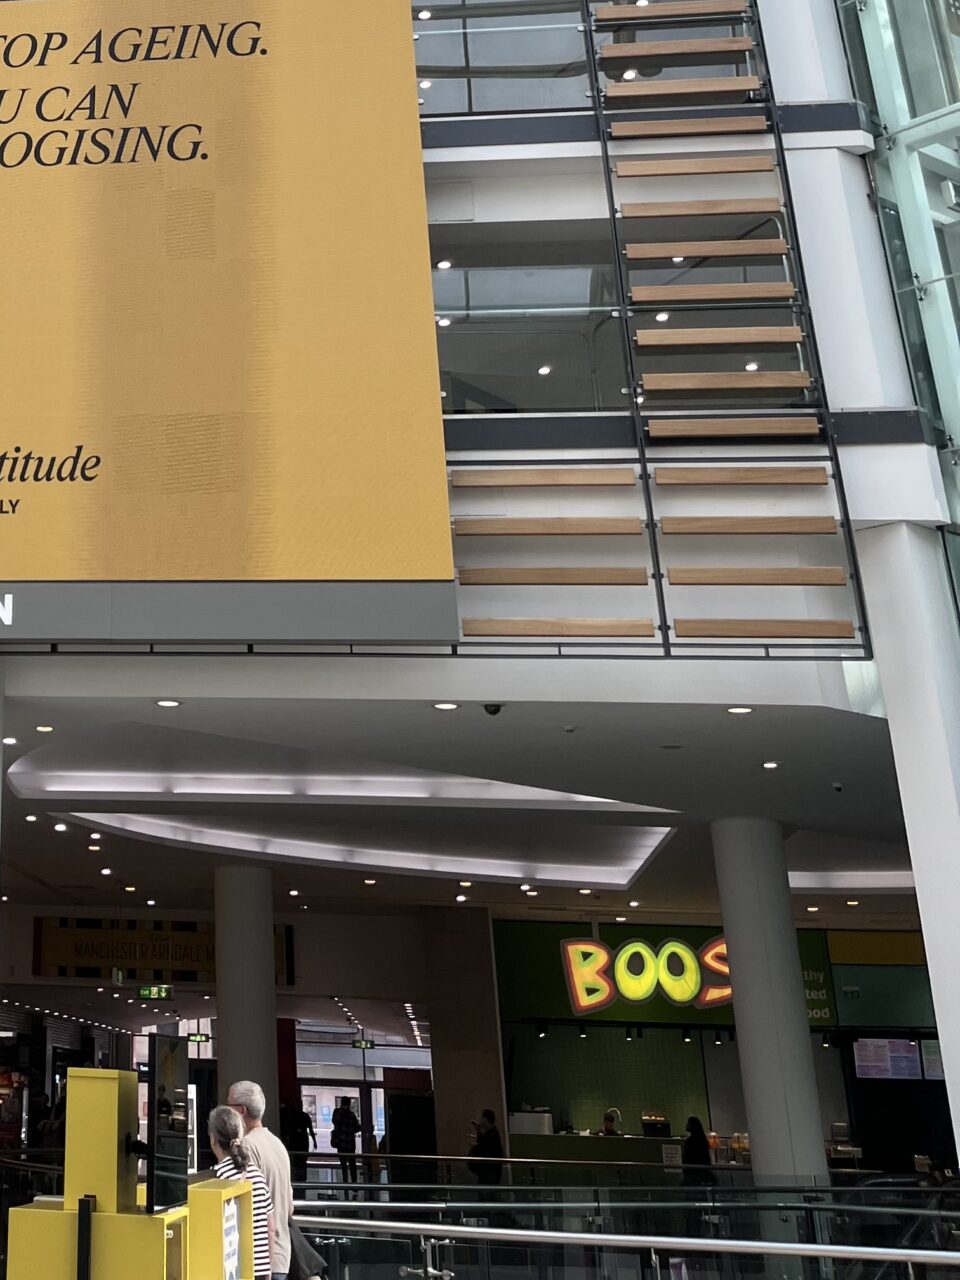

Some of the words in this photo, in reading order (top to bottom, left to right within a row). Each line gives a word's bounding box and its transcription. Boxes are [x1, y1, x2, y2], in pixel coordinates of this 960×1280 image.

[70, 21, 268, 64] AGEING.
[35, 82, 141, 121] CAN
[562, 937, 732, 1015] BOOS
[805, 988, 827, 1000] ted
